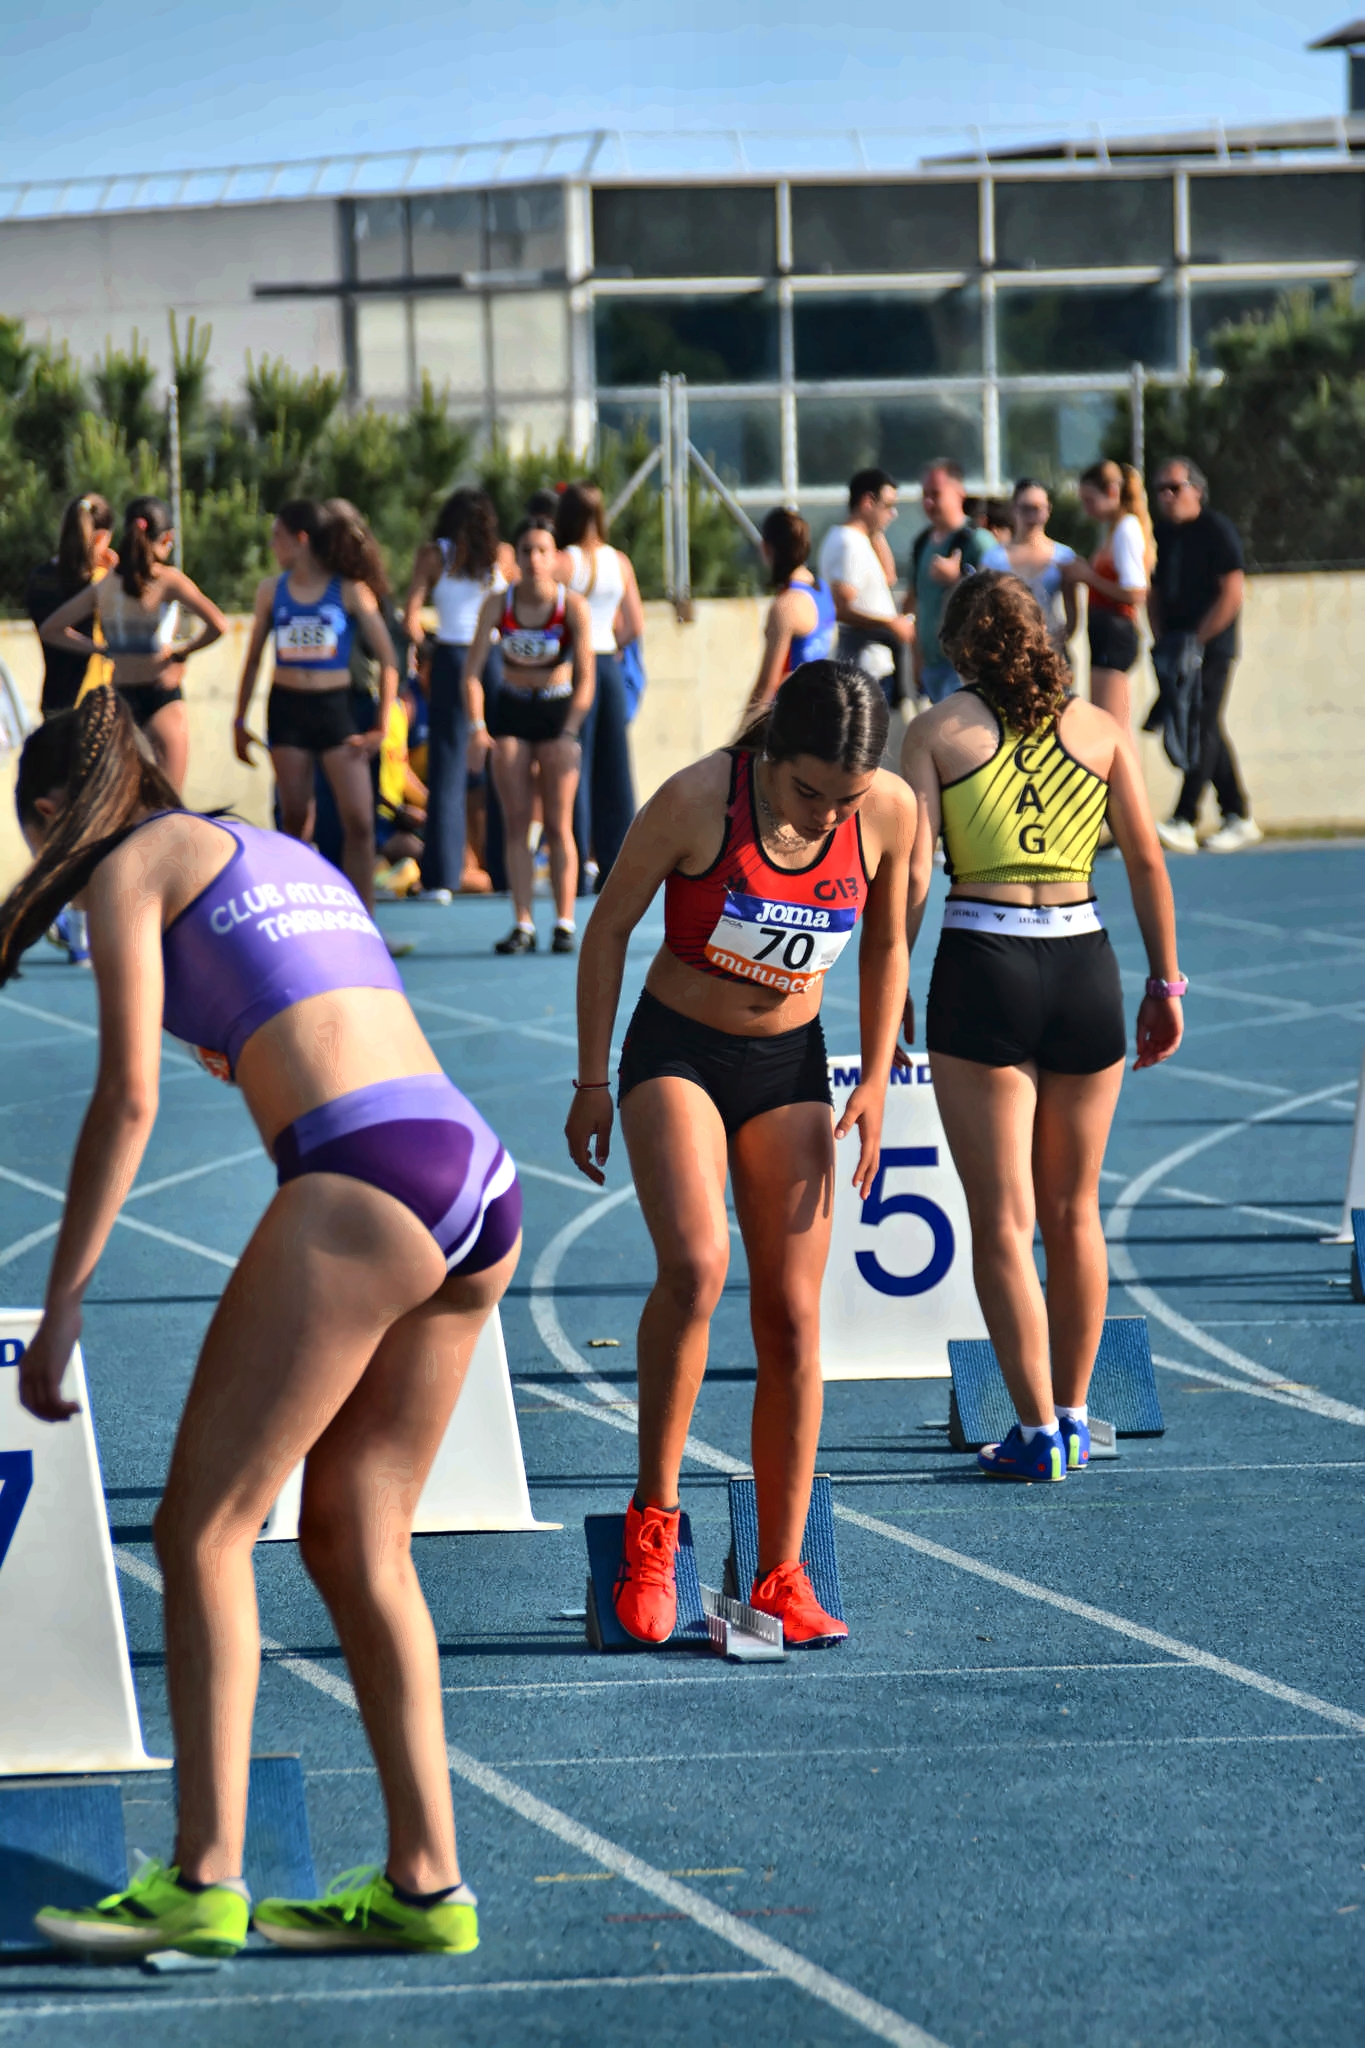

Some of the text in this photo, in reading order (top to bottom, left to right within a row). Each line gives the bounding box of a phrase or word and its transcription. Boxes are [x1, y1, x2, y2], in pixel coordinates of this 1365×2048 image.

[1013, 745, 1046, 854] CAG
[210, 883, 285, 935] CLUB
[753, 927, 815, 970] 70
[854, 1146, 955, 1297] 5
